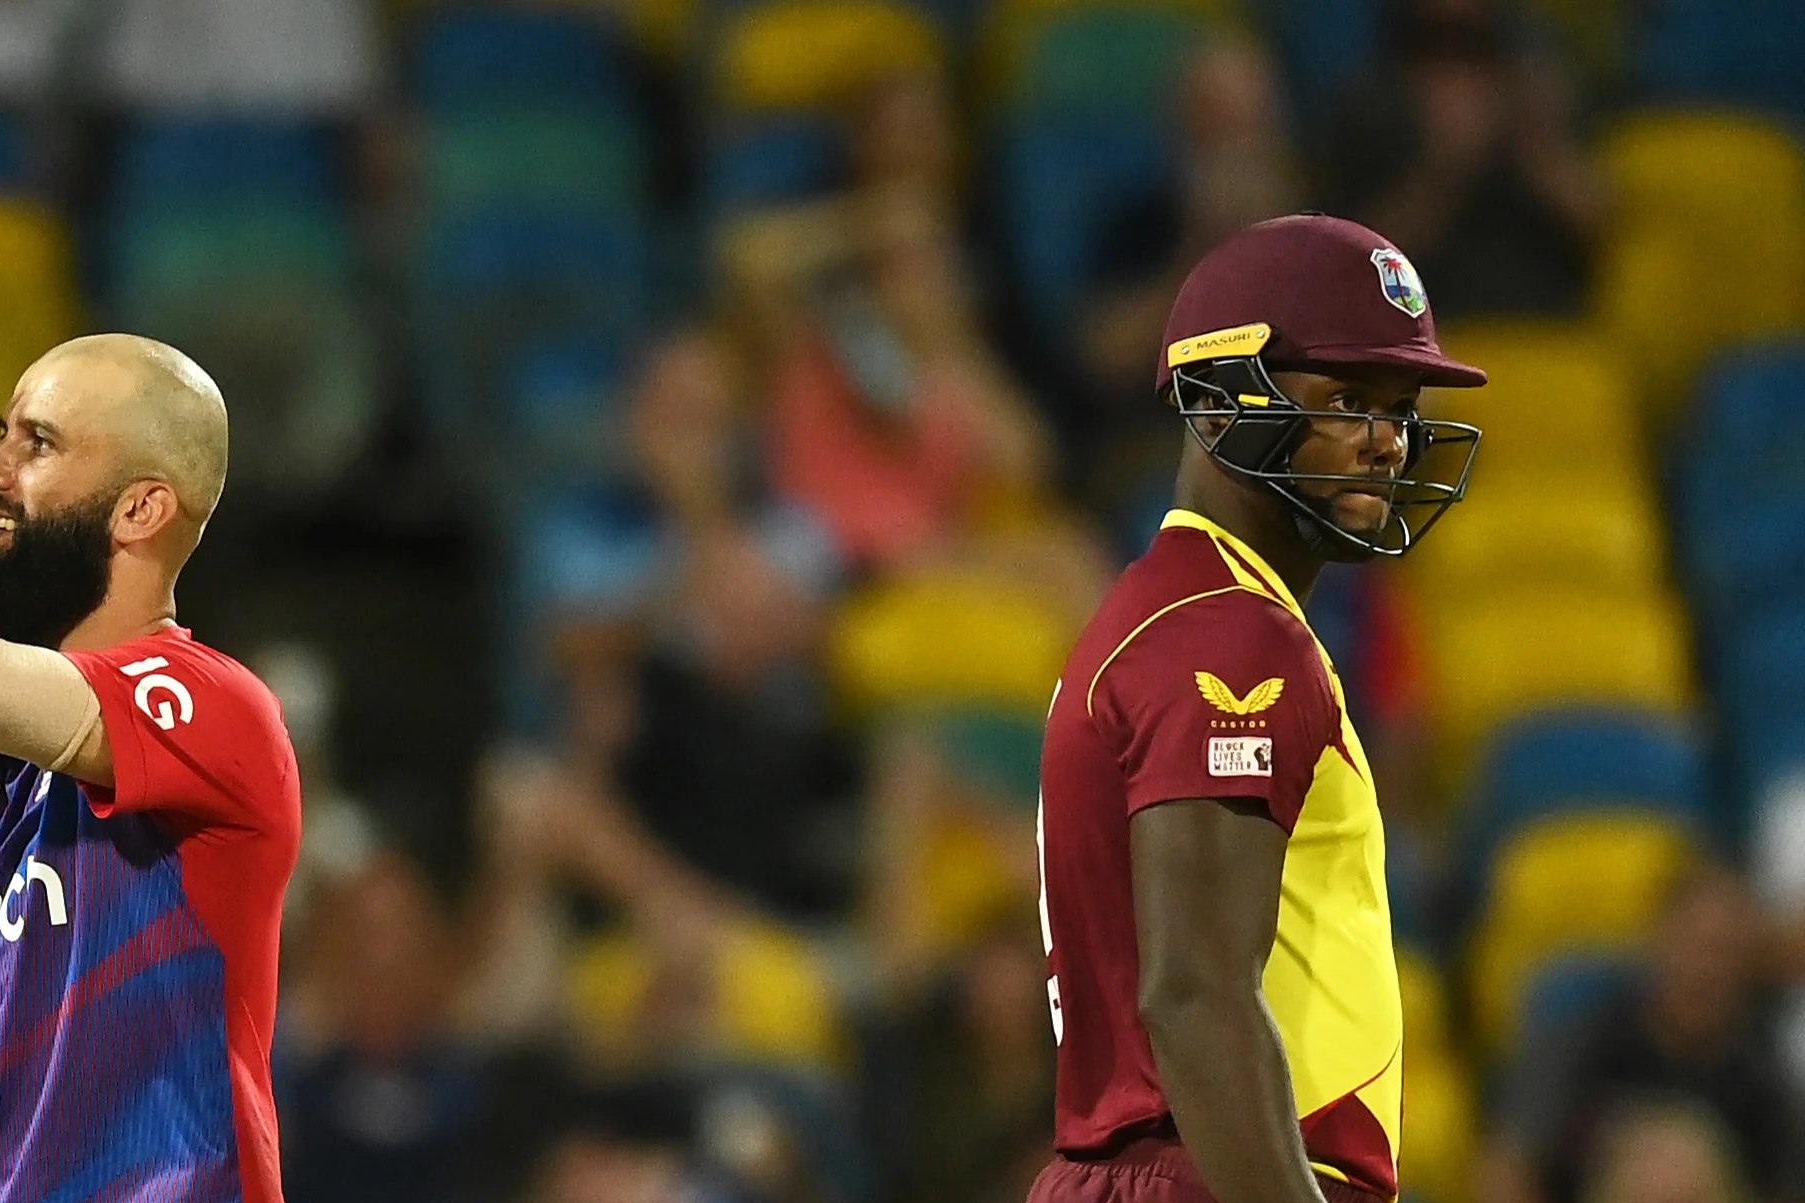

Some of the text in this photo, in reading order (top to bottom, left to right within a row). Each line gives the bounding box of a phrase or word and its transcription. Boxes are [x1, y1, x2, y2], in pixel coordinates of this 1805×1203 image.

[1196, 332, 1251, 350] MASURI
[120, 655, 194, 731] IG
[1213, 752, 1242, 762] LIVES
